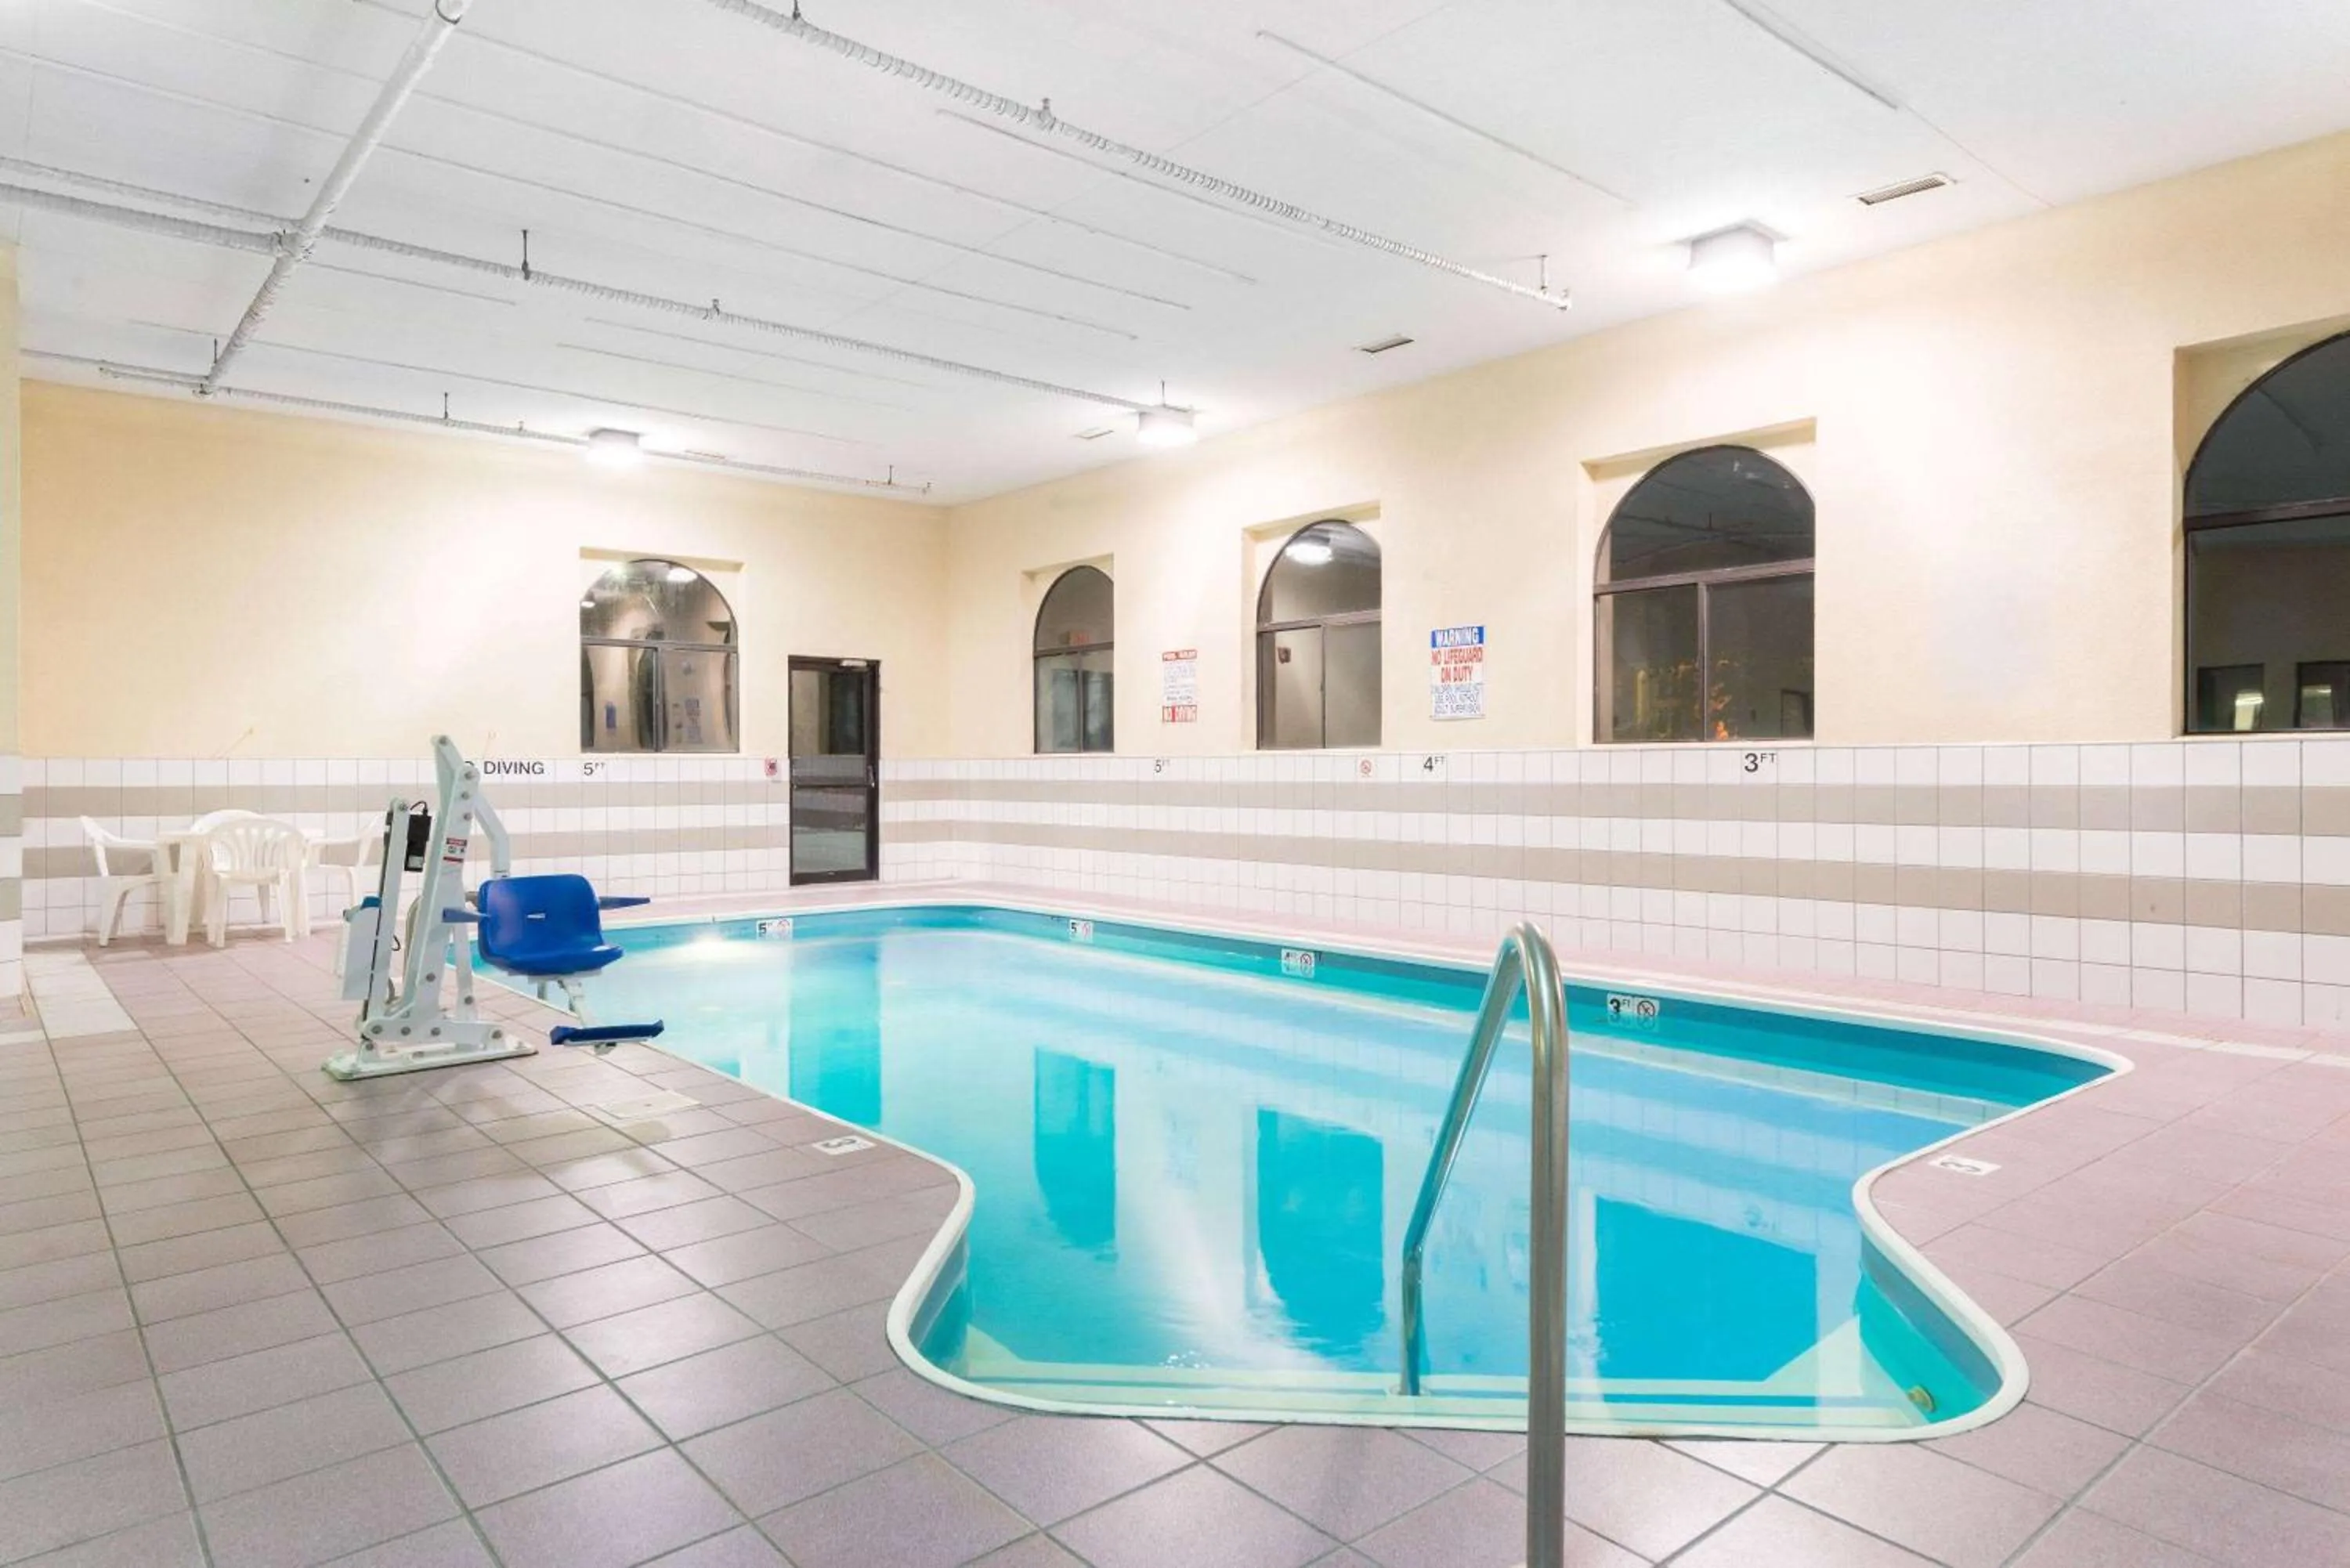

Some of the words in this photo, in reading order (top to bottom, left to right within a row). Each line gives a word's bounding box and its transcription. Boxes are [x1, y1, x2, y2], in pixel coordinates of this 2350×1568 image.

[1436, 627, 1479, 646] WARNING
[1444, 647, 1483, 664] LIFEGUARD
[1453, 665, 1472, 681] DUTY
[483, 761, 544, 775] DIVING
